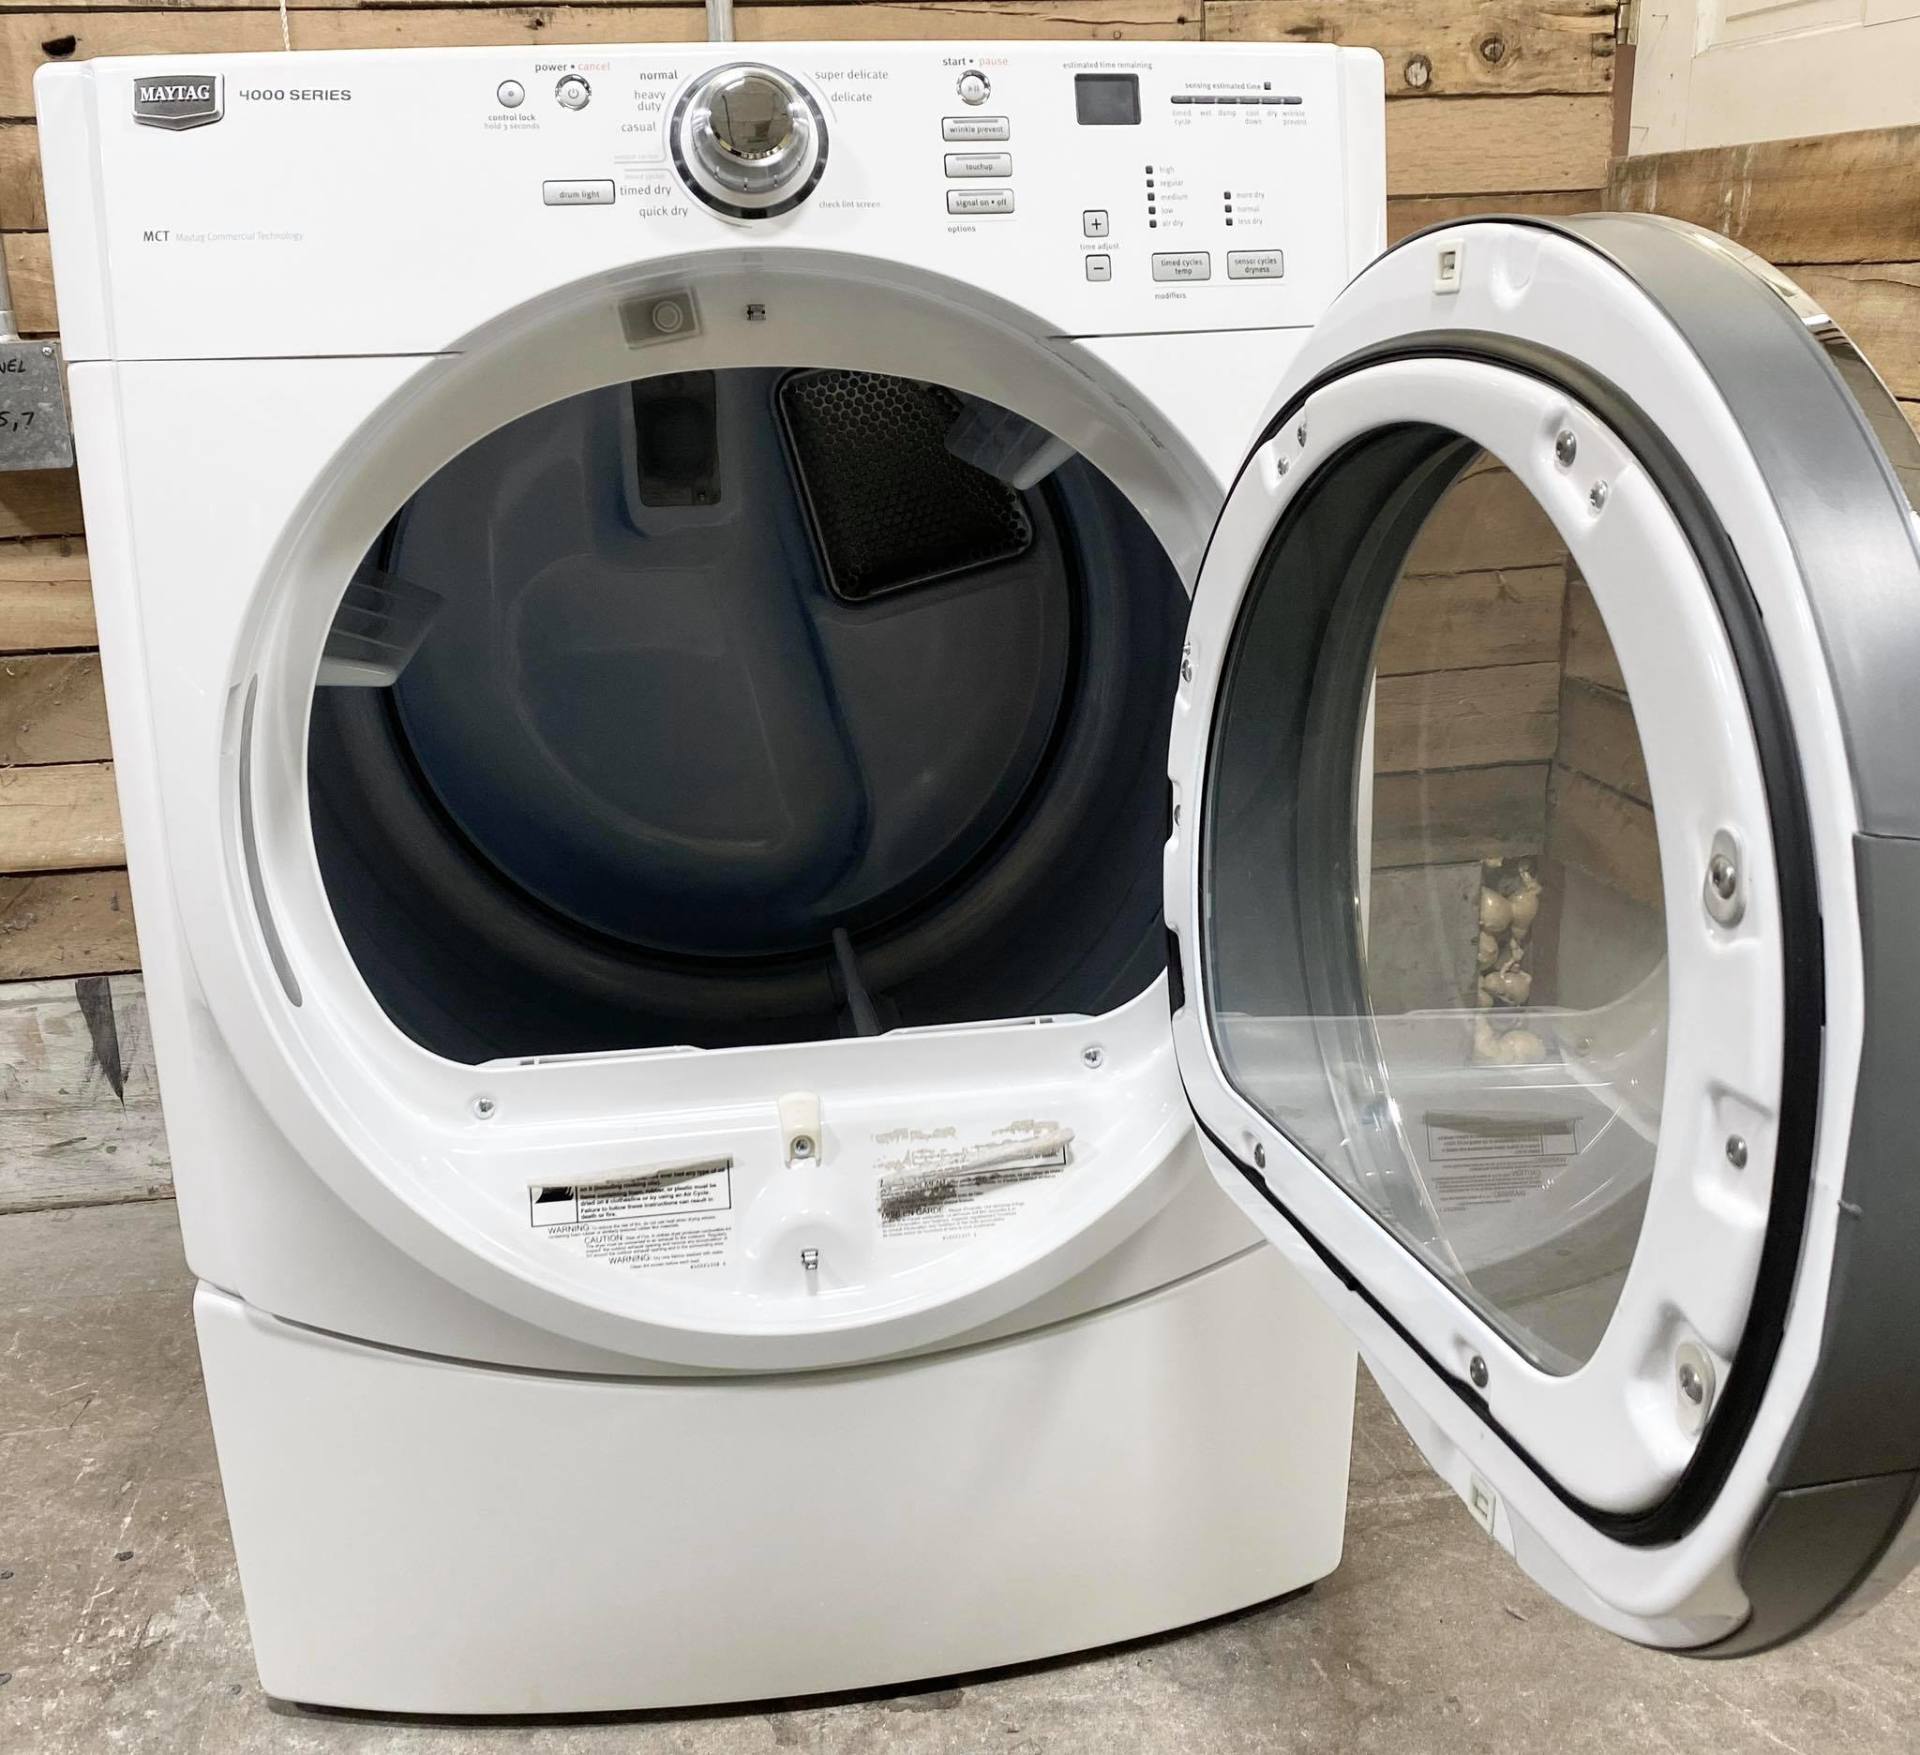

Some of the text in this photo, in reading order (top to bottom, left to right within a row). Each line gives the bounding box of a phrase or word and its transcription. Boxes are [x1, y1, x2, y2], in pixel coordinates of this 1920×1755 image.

[942, 57, 1008, 67] start pause
[1063, 61, 1152, 70] estimated time remaining
[535, 62, 610, 73] power cancel
[639, 70, 678, 80] normal
[815, 70, 888, 81] super delicate
[1185, 82, 1211, 90] sensing
[140, 84, 211, 103] MAYTAG
[239, 89, 352, 101] 4000 SERIES
[634, 90, 666, 101] heavy
[831, 92, 872, 102] delicate
[637, 101, 661, 112] duty
[488, 113, 536, 121] control lock
[509, 122, 540, 130] seconds
[621, 121, 656, 132] casual
[949, 125, 1003, 134] wrinkle prevent
[965, 162, 993, 172] touchup
[559, 190, 600, 200] drum light
[620, 185, 672, 197] timed dry
[818, 200, 840, 208] check
[842, 200, 854, 208] lint
[956, 198, 978, 208] signal
[996, 198, 1007, 207] off
[639, 205, 688, 218] quick dry
[947, 225, 976, 233] options
[143, 230, 170, 242] MCT
[176, 231, 304, 243] Maytag Commercial Technology
[1097, 242, 1119, 251] adjust
[1161, 258, 1202, 267] timed cycles
[1234, 256, 1277, 265] sensor cycles
[1174, 267, 1192, 276] temp
[1244, 265, 1270, 274] dryness
[1154, 291, 1186, 300] modifiers
[584, 1234, 623, 1245] CAUTION
